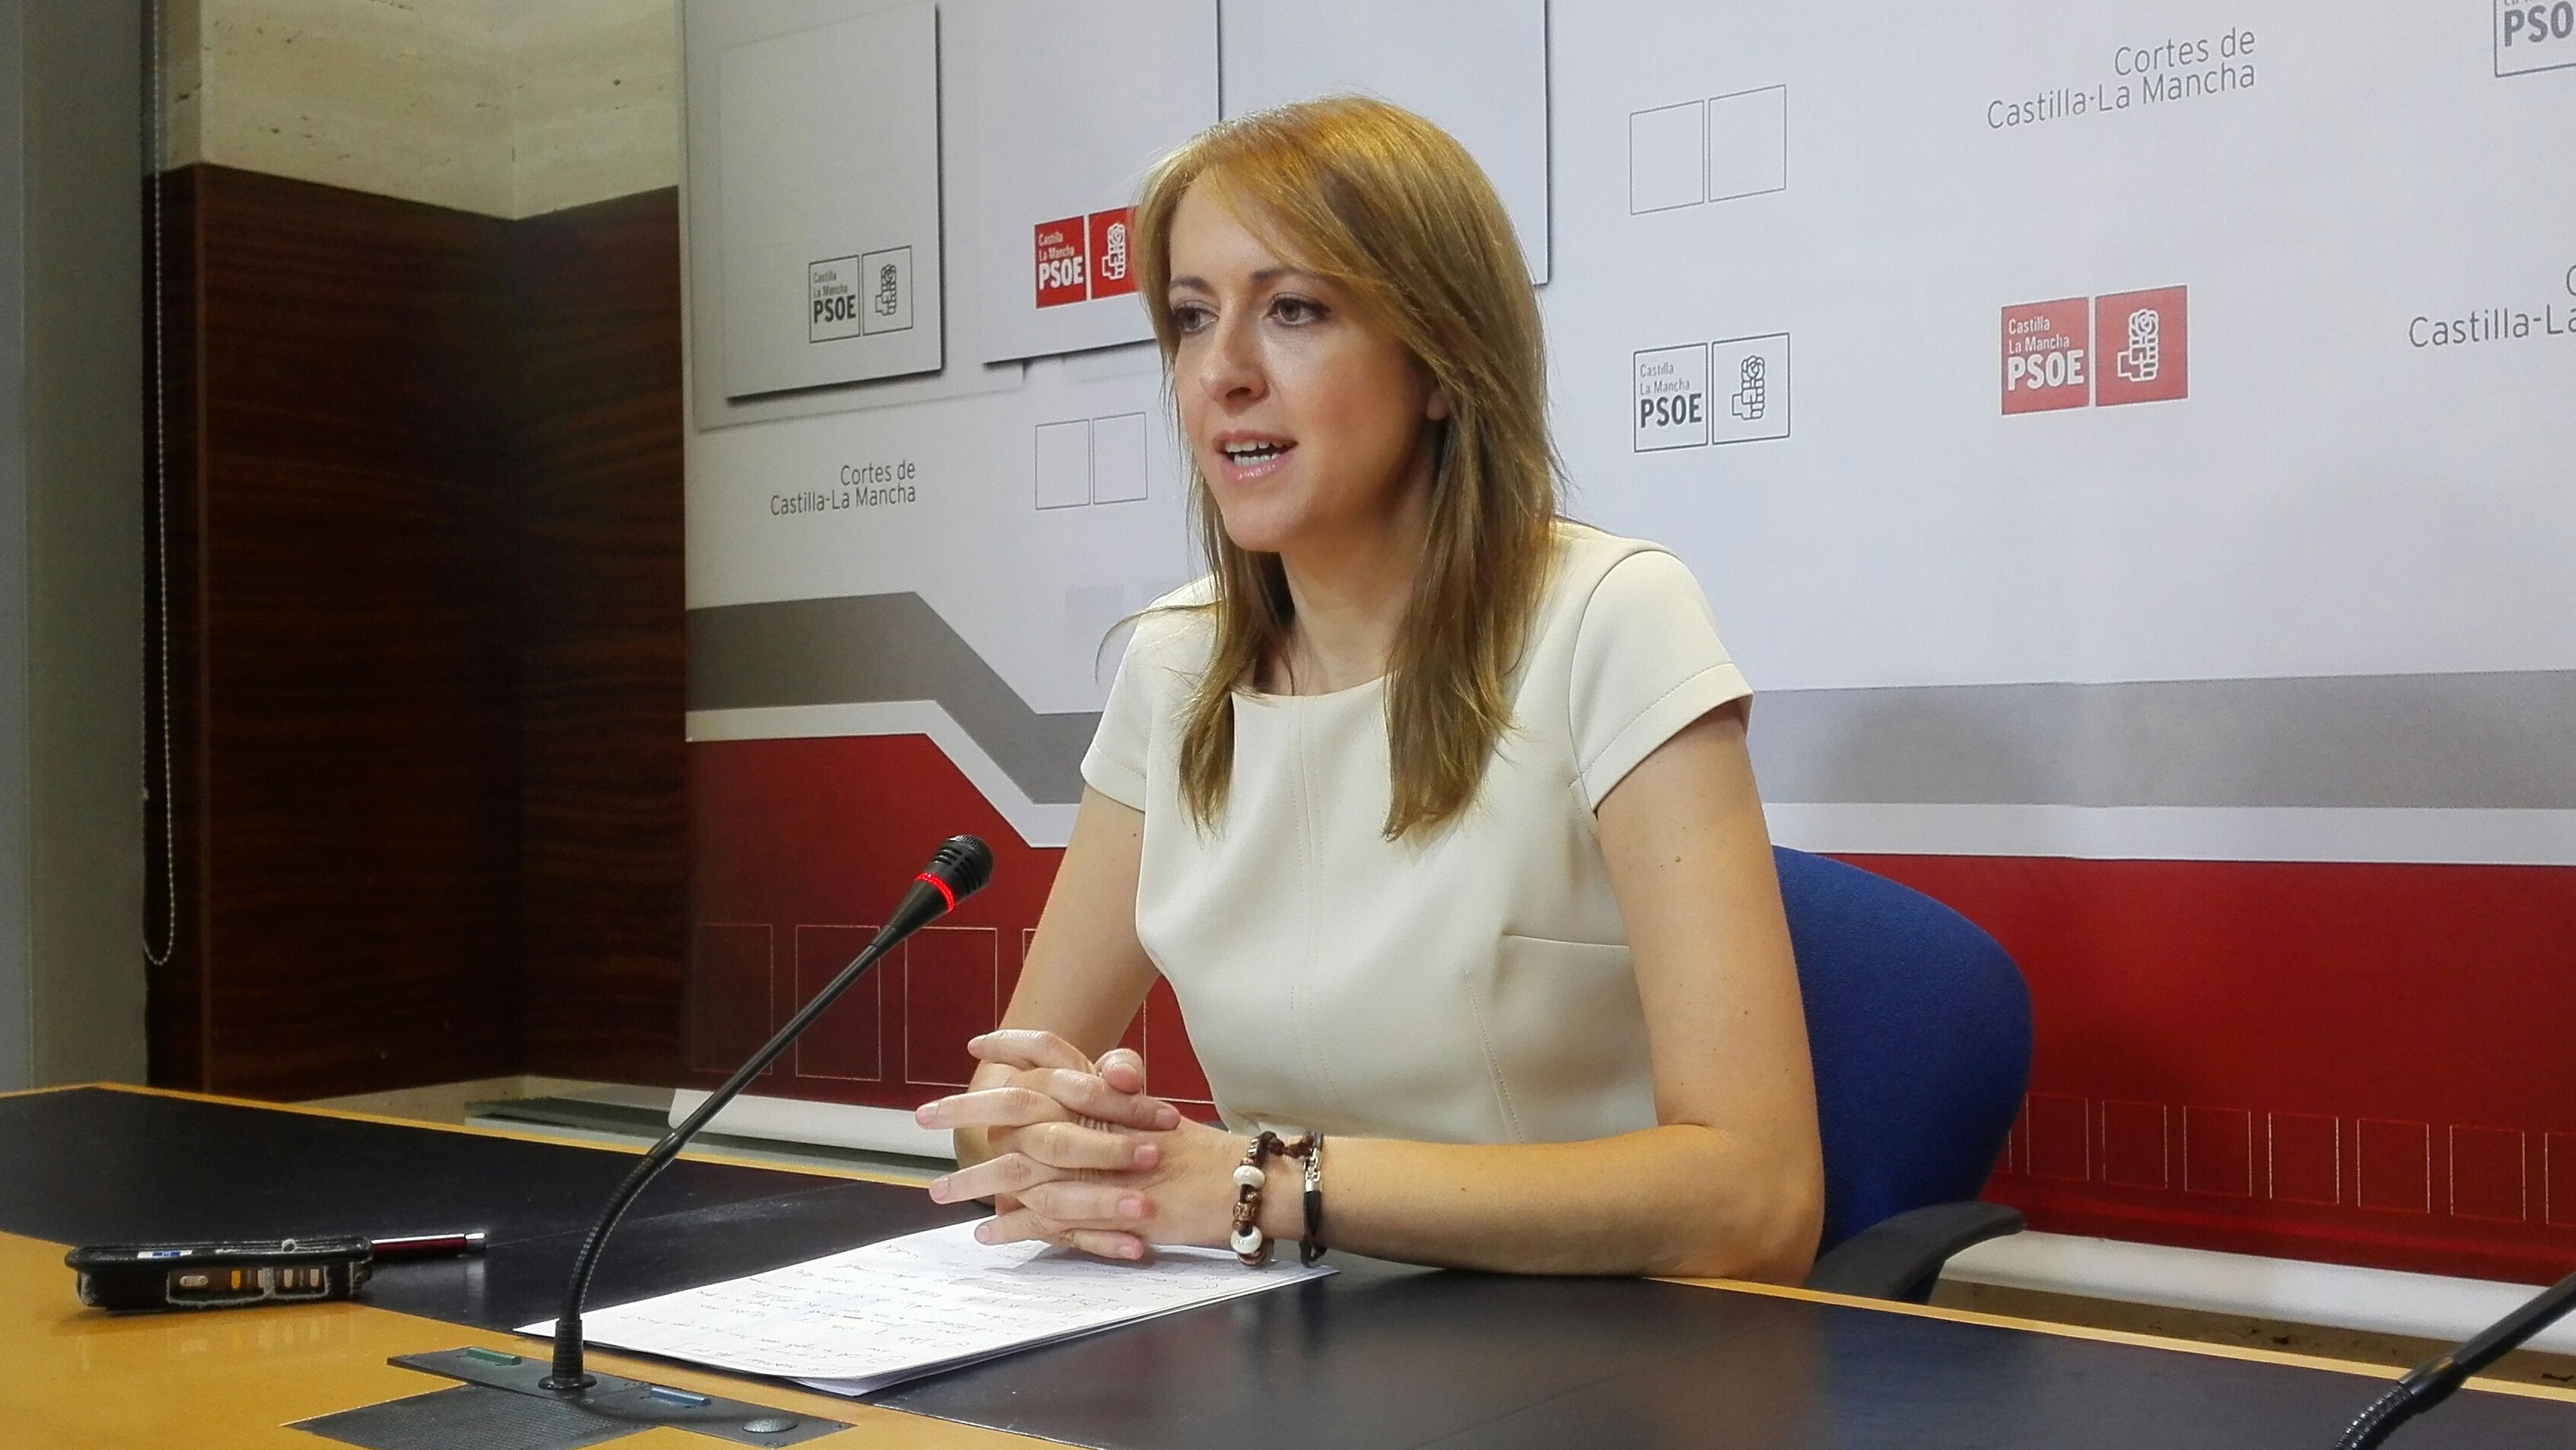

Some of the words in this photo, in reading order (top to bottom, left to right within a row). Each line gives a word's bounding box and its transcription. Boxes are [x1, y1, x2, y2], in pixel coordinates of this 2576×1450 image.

[2115, 38, 2209, 75] Cortes
[2221, 27, 2255, 58] de
[1988, 84, 2130, 129] Castilla-La
[2142, 62, 2255, 104] Mancha
[1038, 231, 1064, 246] Castilla
[1038, 250, 1047, 261] La
[1048, 245, 1075, 259] Mancha
[813, 270, 837, 284] Castilla
[1038, 256, 1084, 290] PSOE
[813, 288, 821, 298] La
[822, 282, 848, 296] Mancha
[813, 294, 857, 324] PSOE
[2008, 316, 2050, 335] Castilla
[2008, 340, 2021, 355] La
[2025, 334, 2069, 352] Mancha
[1640, 361, 1674, 378] Castilla
[2007, 349, 2085, 392] PSOE
[1640, 383, 1650, 396] La
[1654, 378, 1690, 394] Mancha
[1641, 393, 1703, 428] PSOE
[841, 463, 892, 485] Cortes
[897, 459, 915, 481] de
[771, 490, 850, 516] Castilla-La
[856, 482, 916, 507] Mancha
